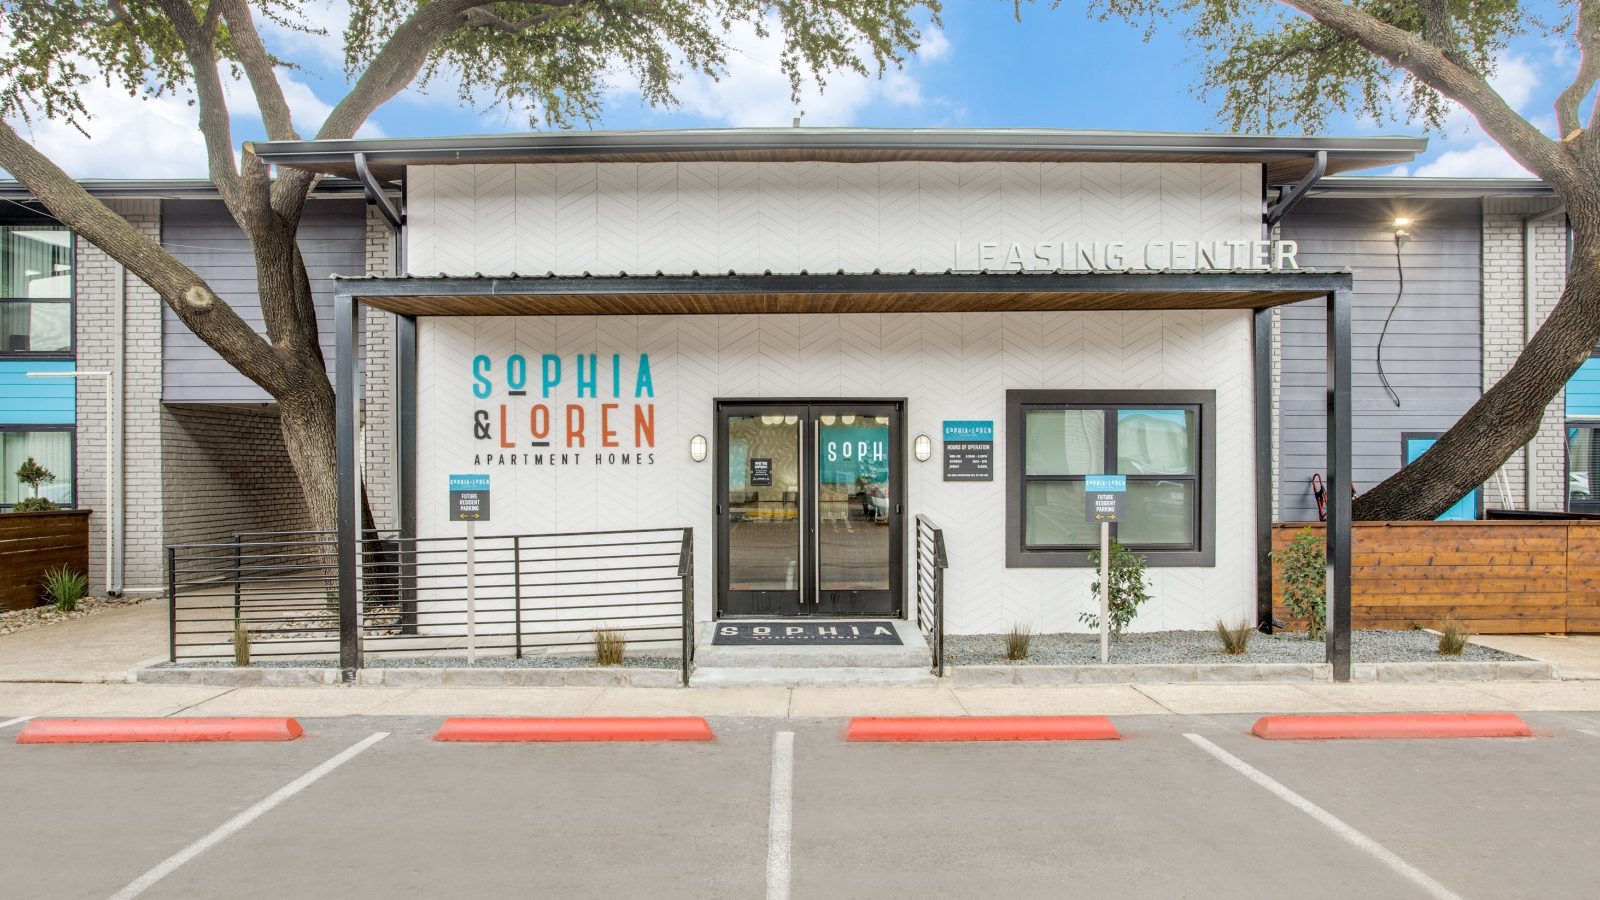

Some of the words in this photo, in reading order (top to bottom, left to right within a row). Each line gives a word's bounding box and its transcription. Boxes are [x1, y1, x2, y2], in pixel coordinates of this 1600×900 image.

[954, 240, 1126, 270] LEASING
[1144, 240, 1300, 270] CENTER
[472, 353, 655, 399] SOPHIA
[474, 409, 492, 440] &
[500, 403, 655, 449] LOREN
[474, 453, 580, 465] APARTMENT
[595, 453, 655, 465] HOMES
[828, 441, 883, 462] SOPH
[720, 626, 892, 636] SOPHIA
